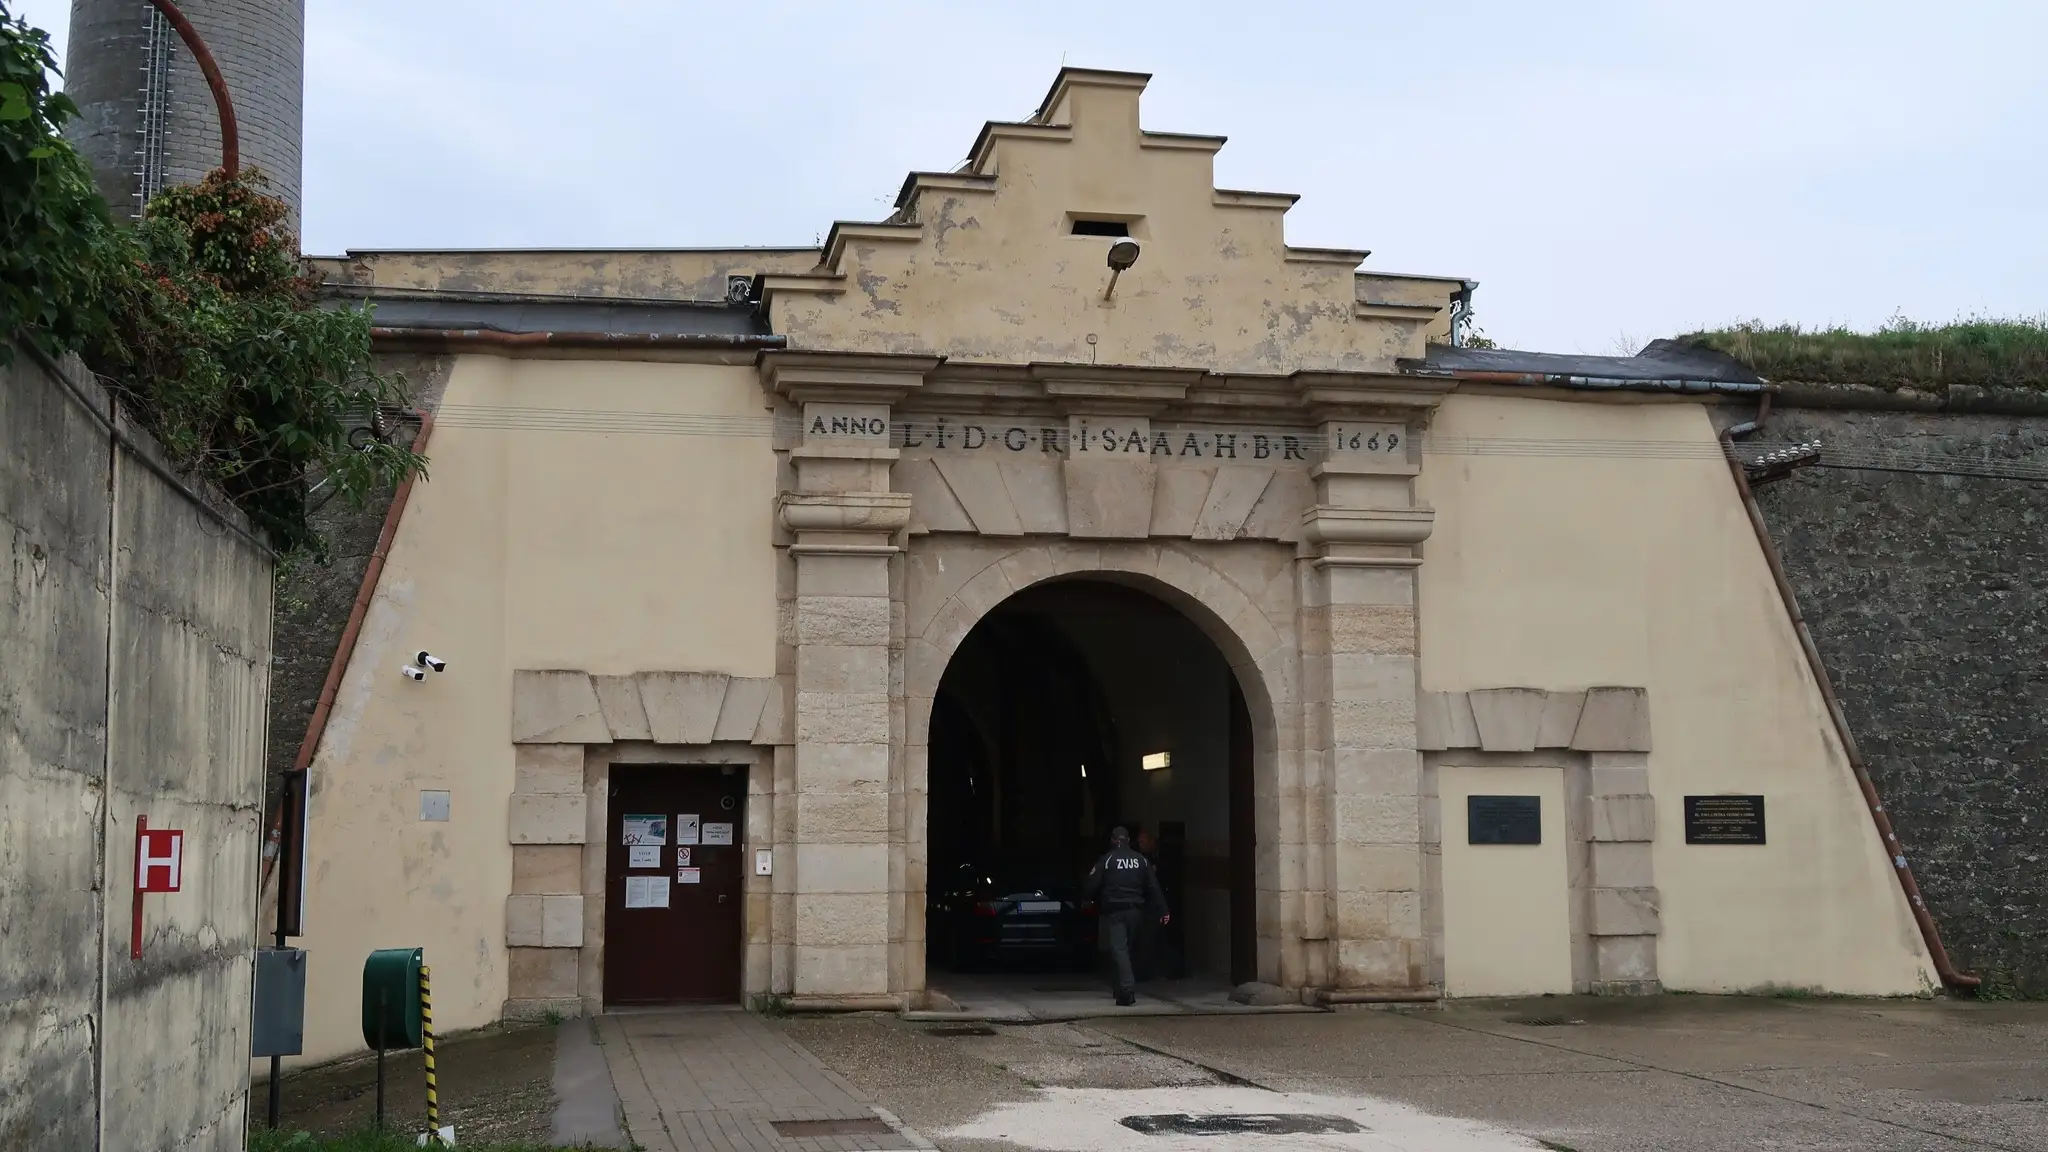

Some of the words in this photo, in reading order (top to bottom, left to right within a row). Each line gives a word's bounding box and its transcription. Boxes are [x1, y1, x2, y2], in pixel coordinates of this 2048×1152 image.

[809, 415, 886, 436] ANNO
[138, 835, 181, 889] H
[1116, 858, 1140, 870] ZVJS
